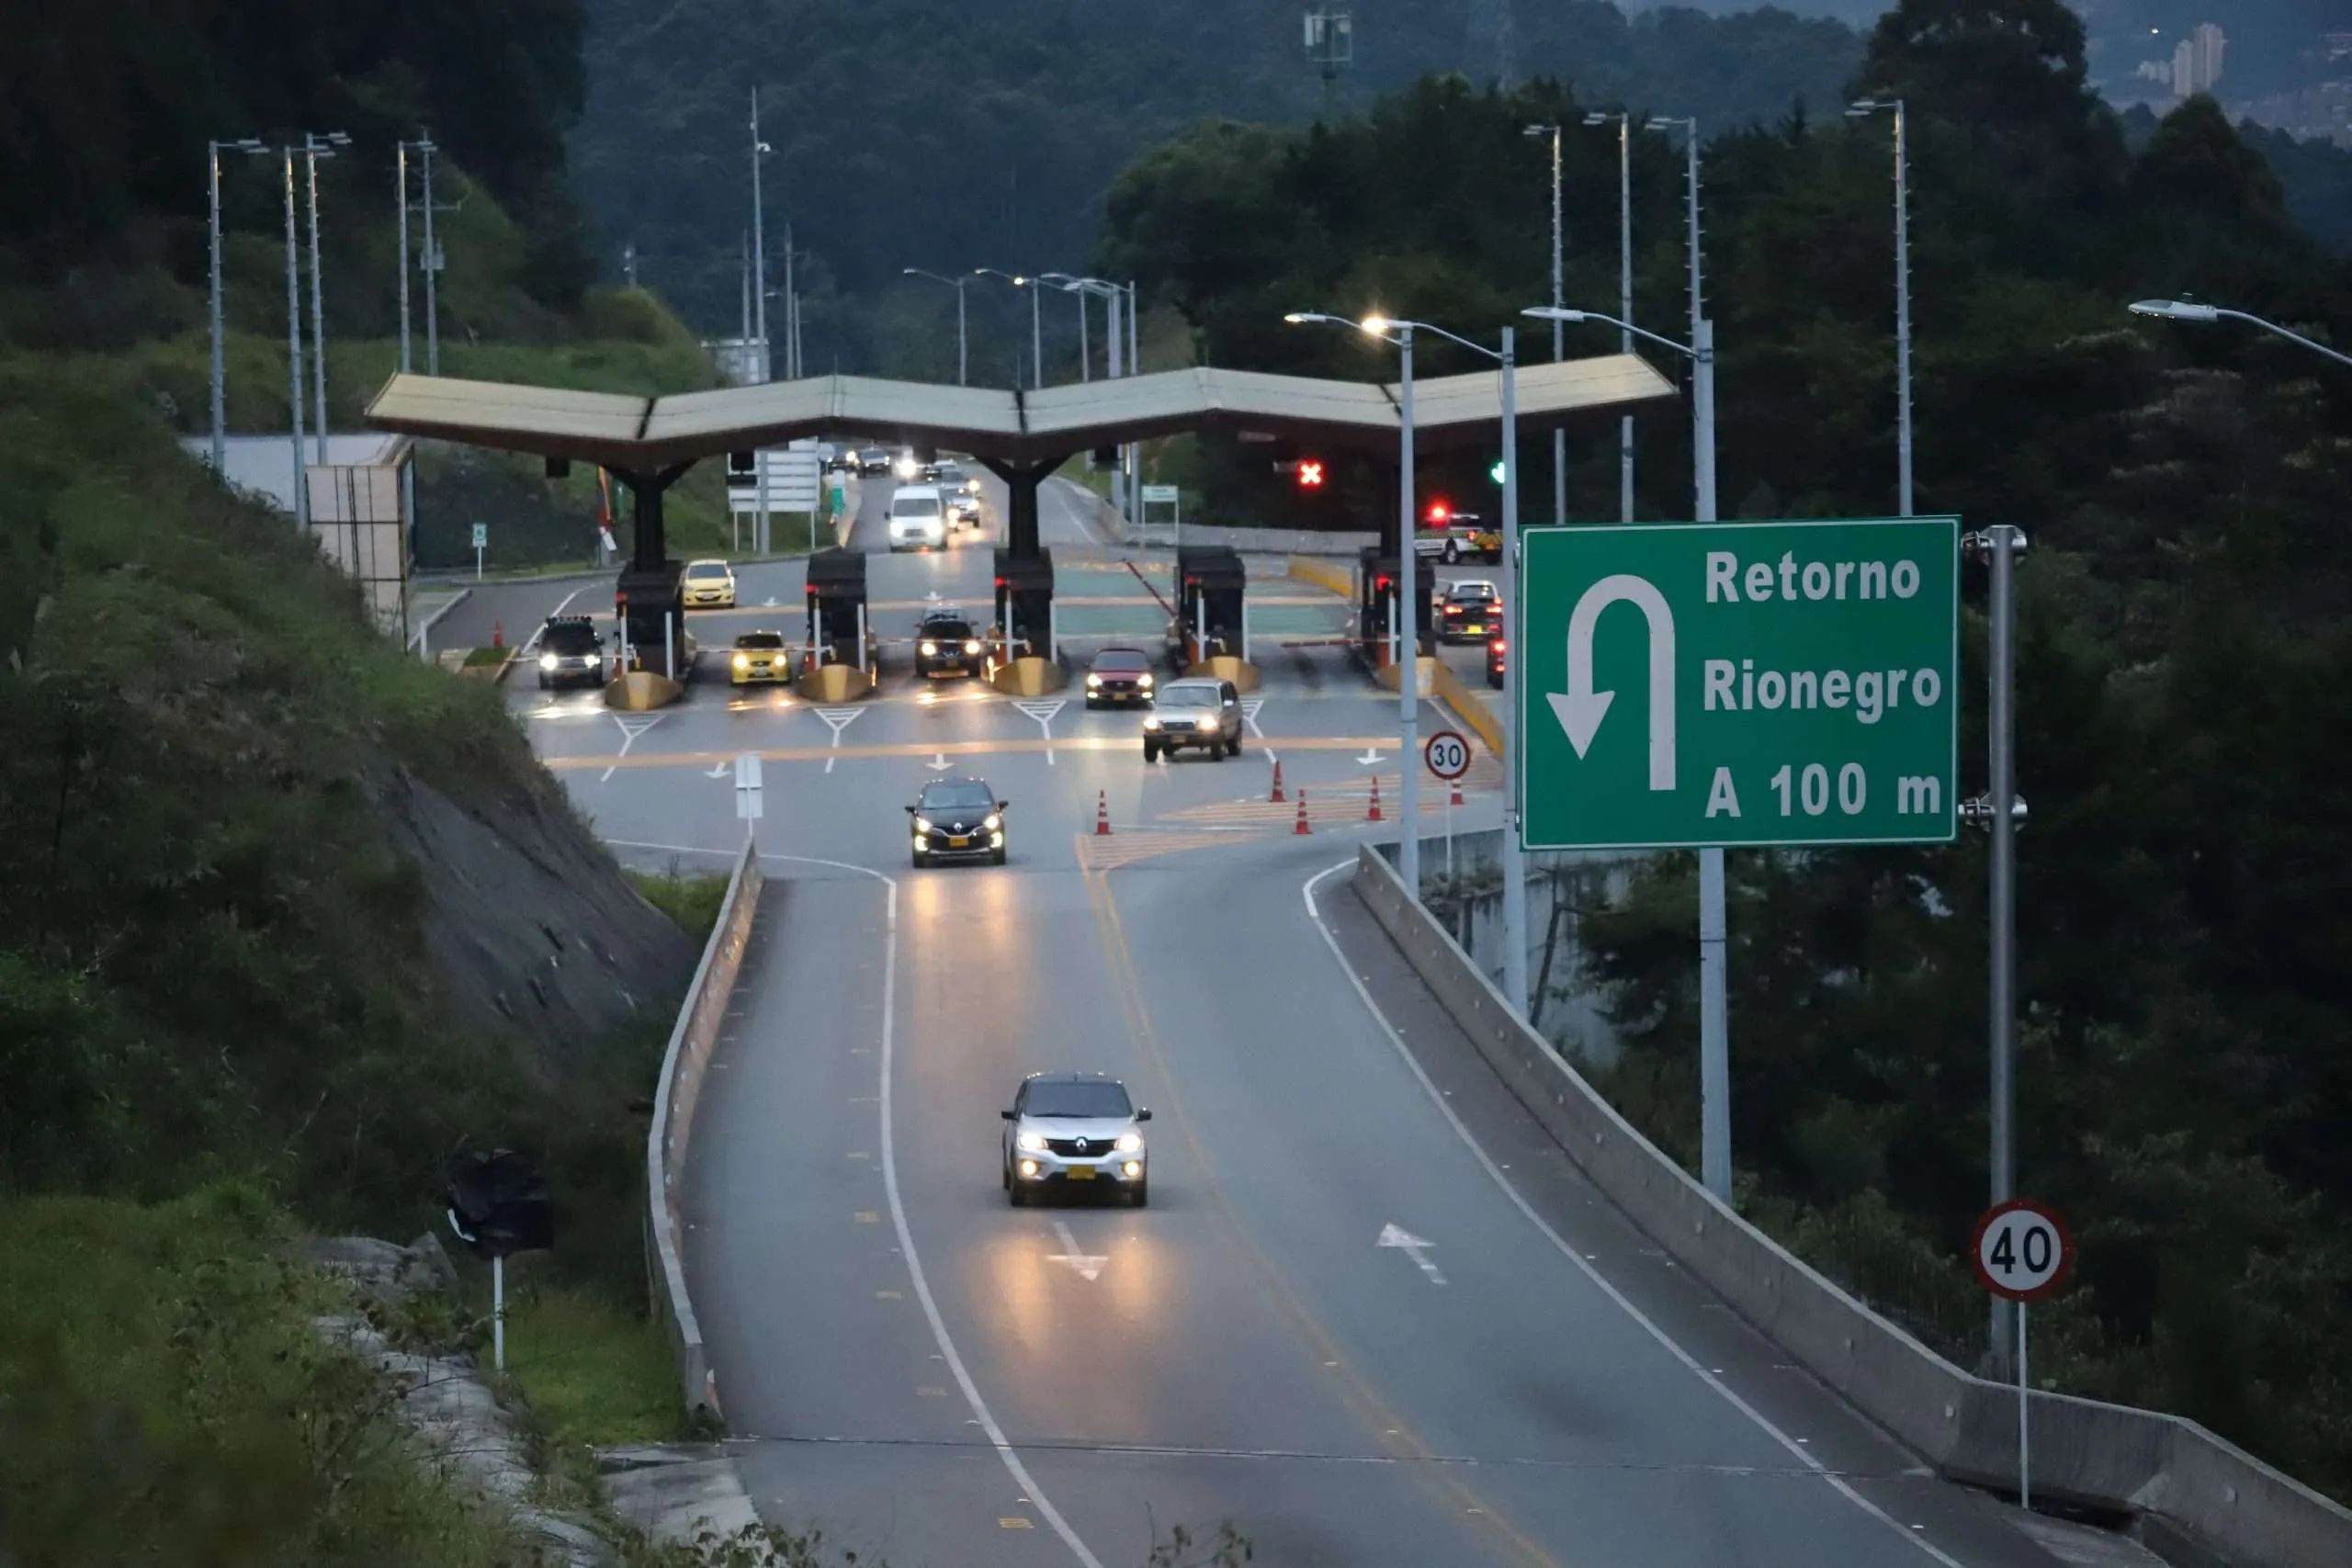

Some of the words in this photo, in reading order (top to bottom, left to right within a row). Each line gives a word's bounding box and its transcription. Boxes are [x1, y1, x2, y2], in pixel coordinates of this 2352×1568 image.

[1707, 551, 1919, 603] Retorno
[1703, 659, 1941, 724] Rionegro
[1434, 744, 1462, 767] 30
[1704, 766, 1741, 818] A
[1771, 763, 1865, 816] 100
[1897, 774, 1940, 815] m
[1990, 1225, 2052, 1274] 40
